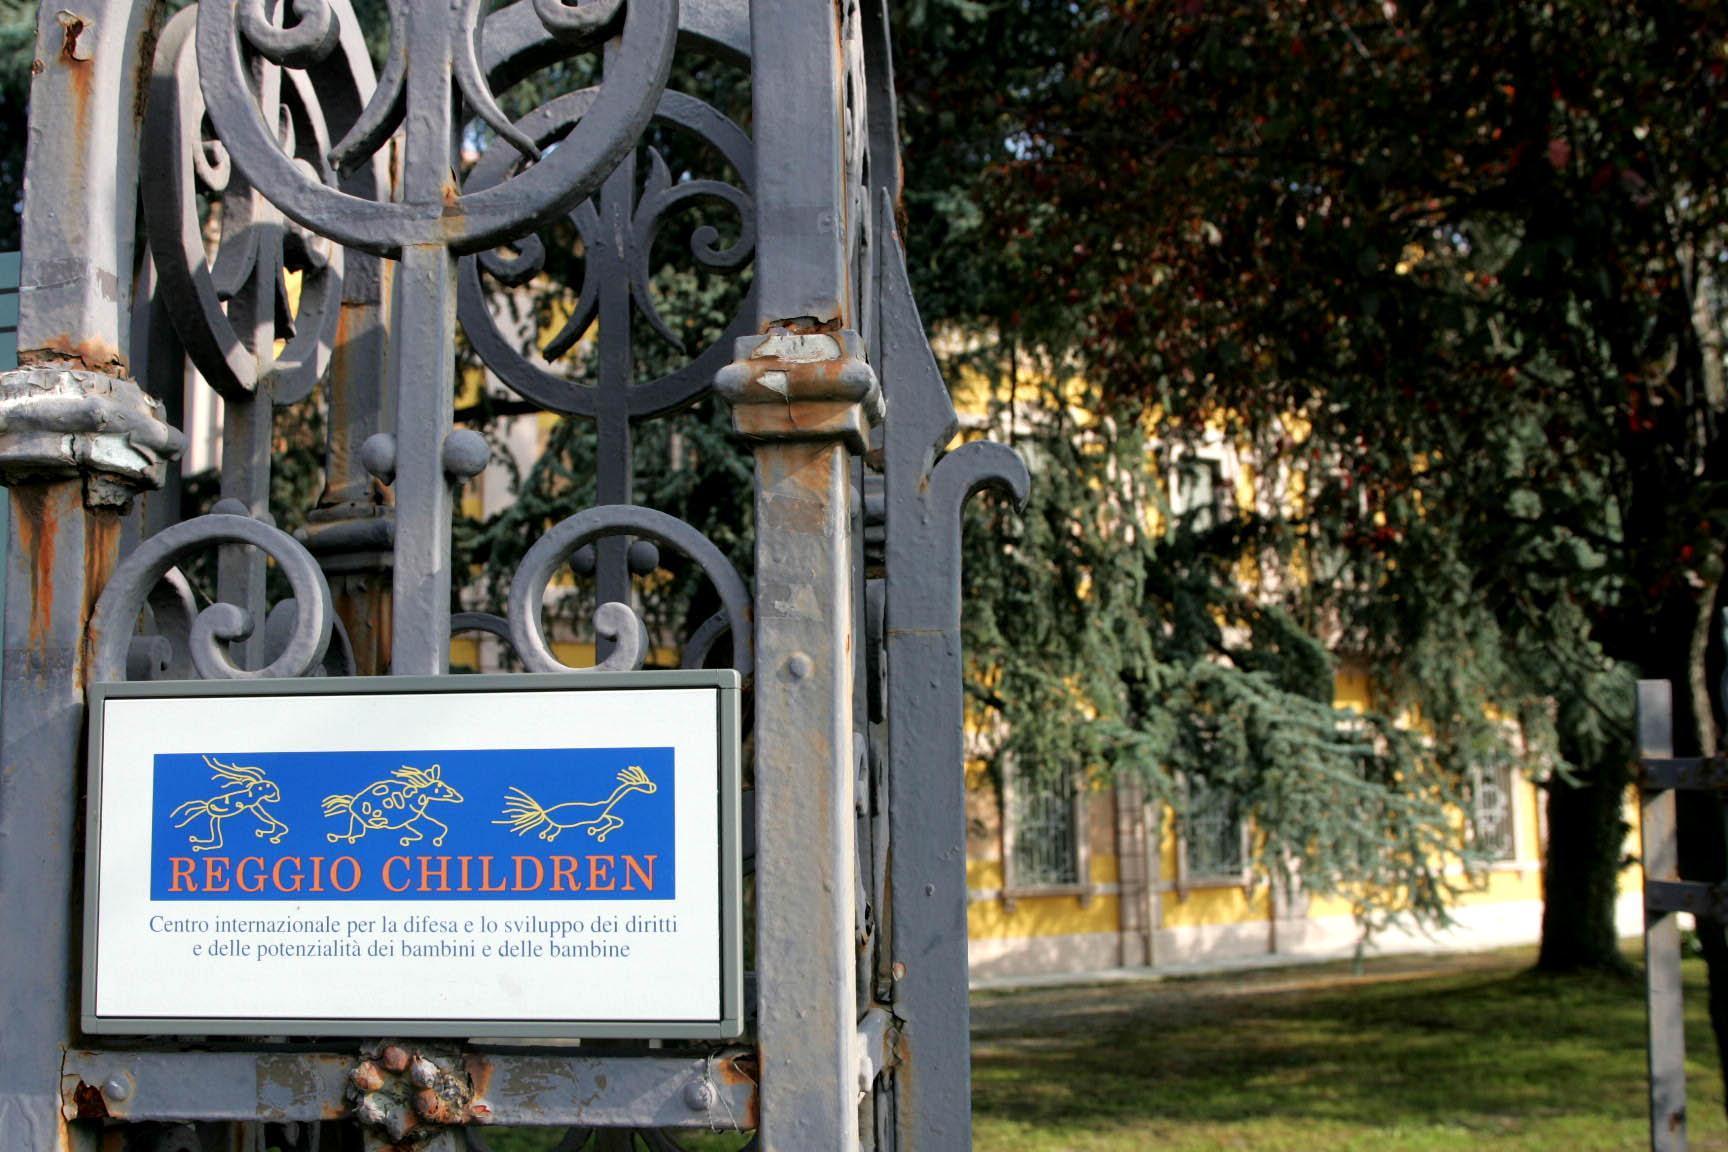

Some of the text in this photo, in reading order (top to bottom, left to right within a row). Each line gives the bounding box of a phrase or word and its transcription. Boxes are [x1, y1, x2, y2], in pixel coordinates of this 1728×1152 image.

[167, 854, 658, 893] REGGIO CHILDREN
[149, 915, 677, 939] Centro internazionale per la difesa e lo sviluppo dei diritti
[192, 939, 630, 962] e delle potenzialità dei bambini e delle bambine
